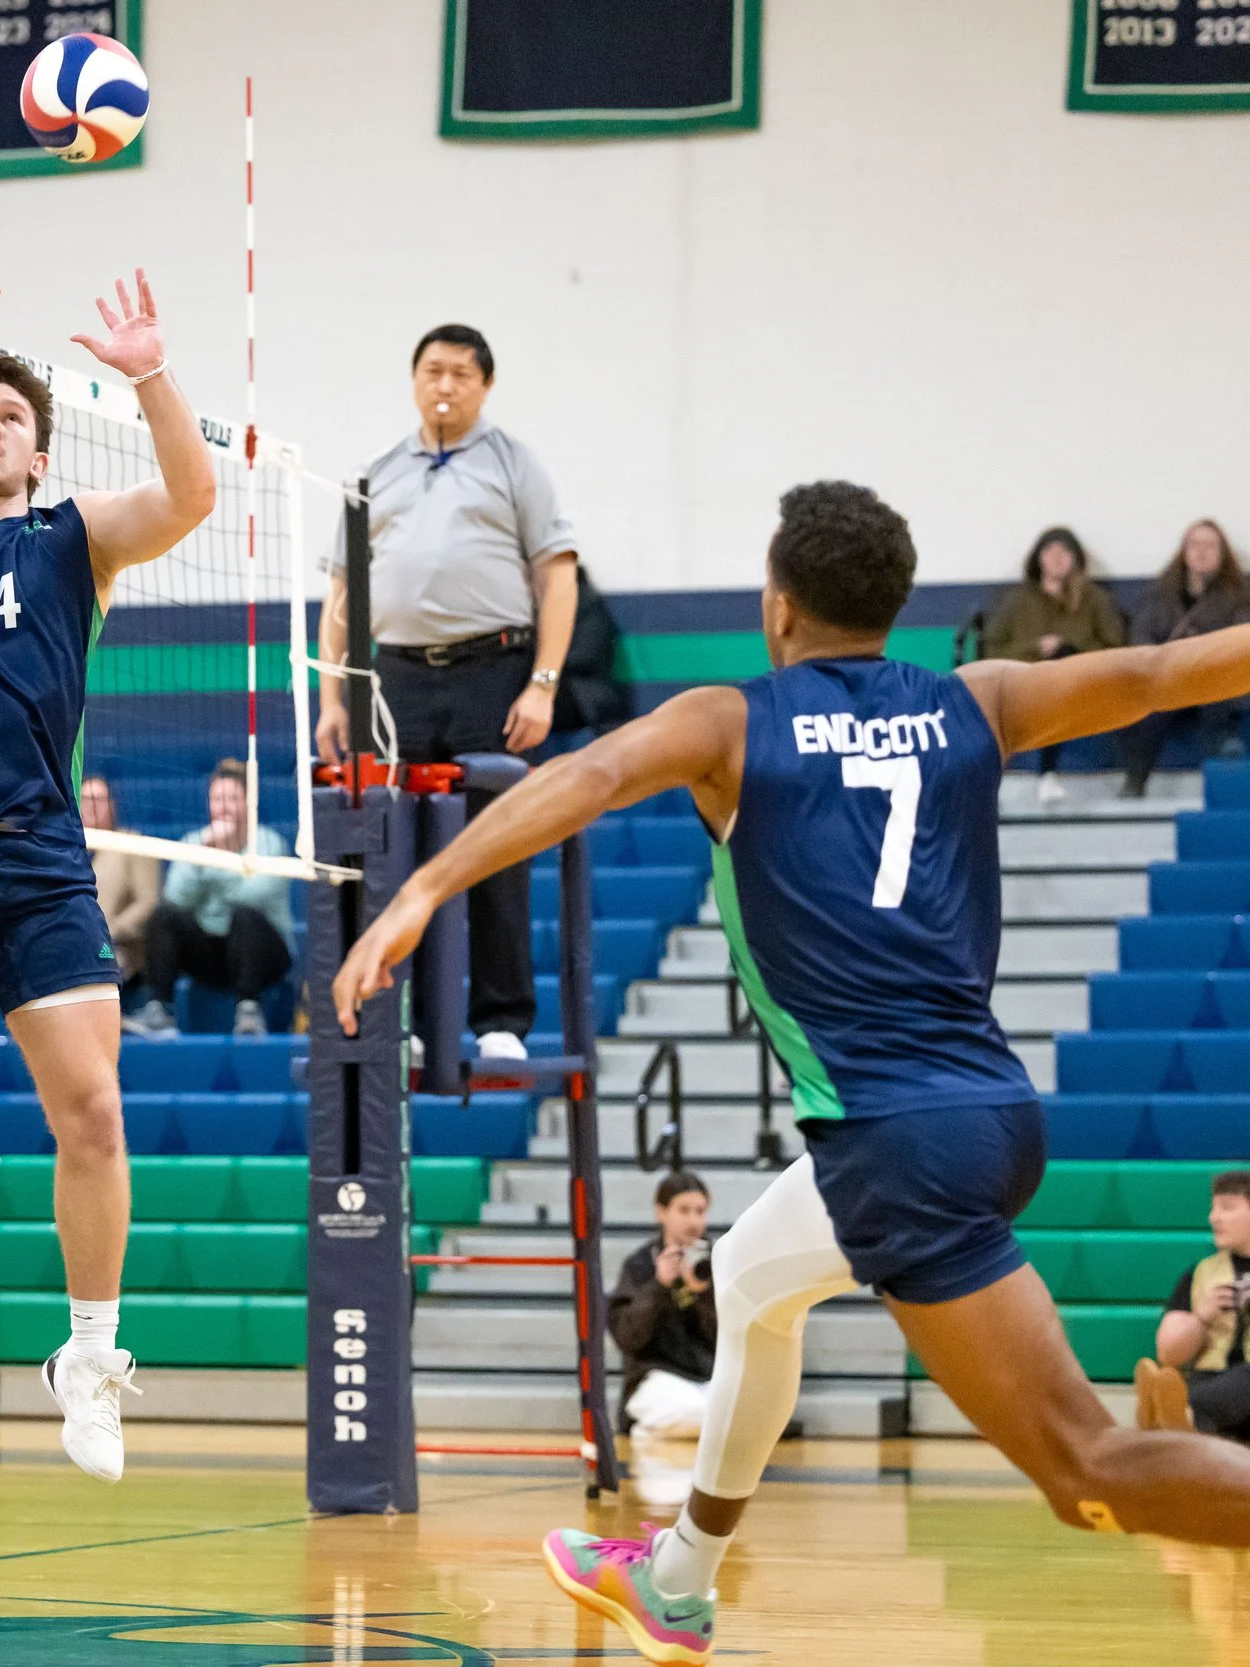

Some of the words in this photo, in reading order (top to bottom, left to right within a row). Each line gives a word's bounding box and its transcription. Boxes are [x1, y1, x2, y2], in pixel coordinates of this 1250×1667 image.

[1103, 16, 1177, 47] 2013
[1195, 15, 1250, 47] 202
[792, 708, 948, 758] ENDCOTT
[841, 755, 922, 909] 7
